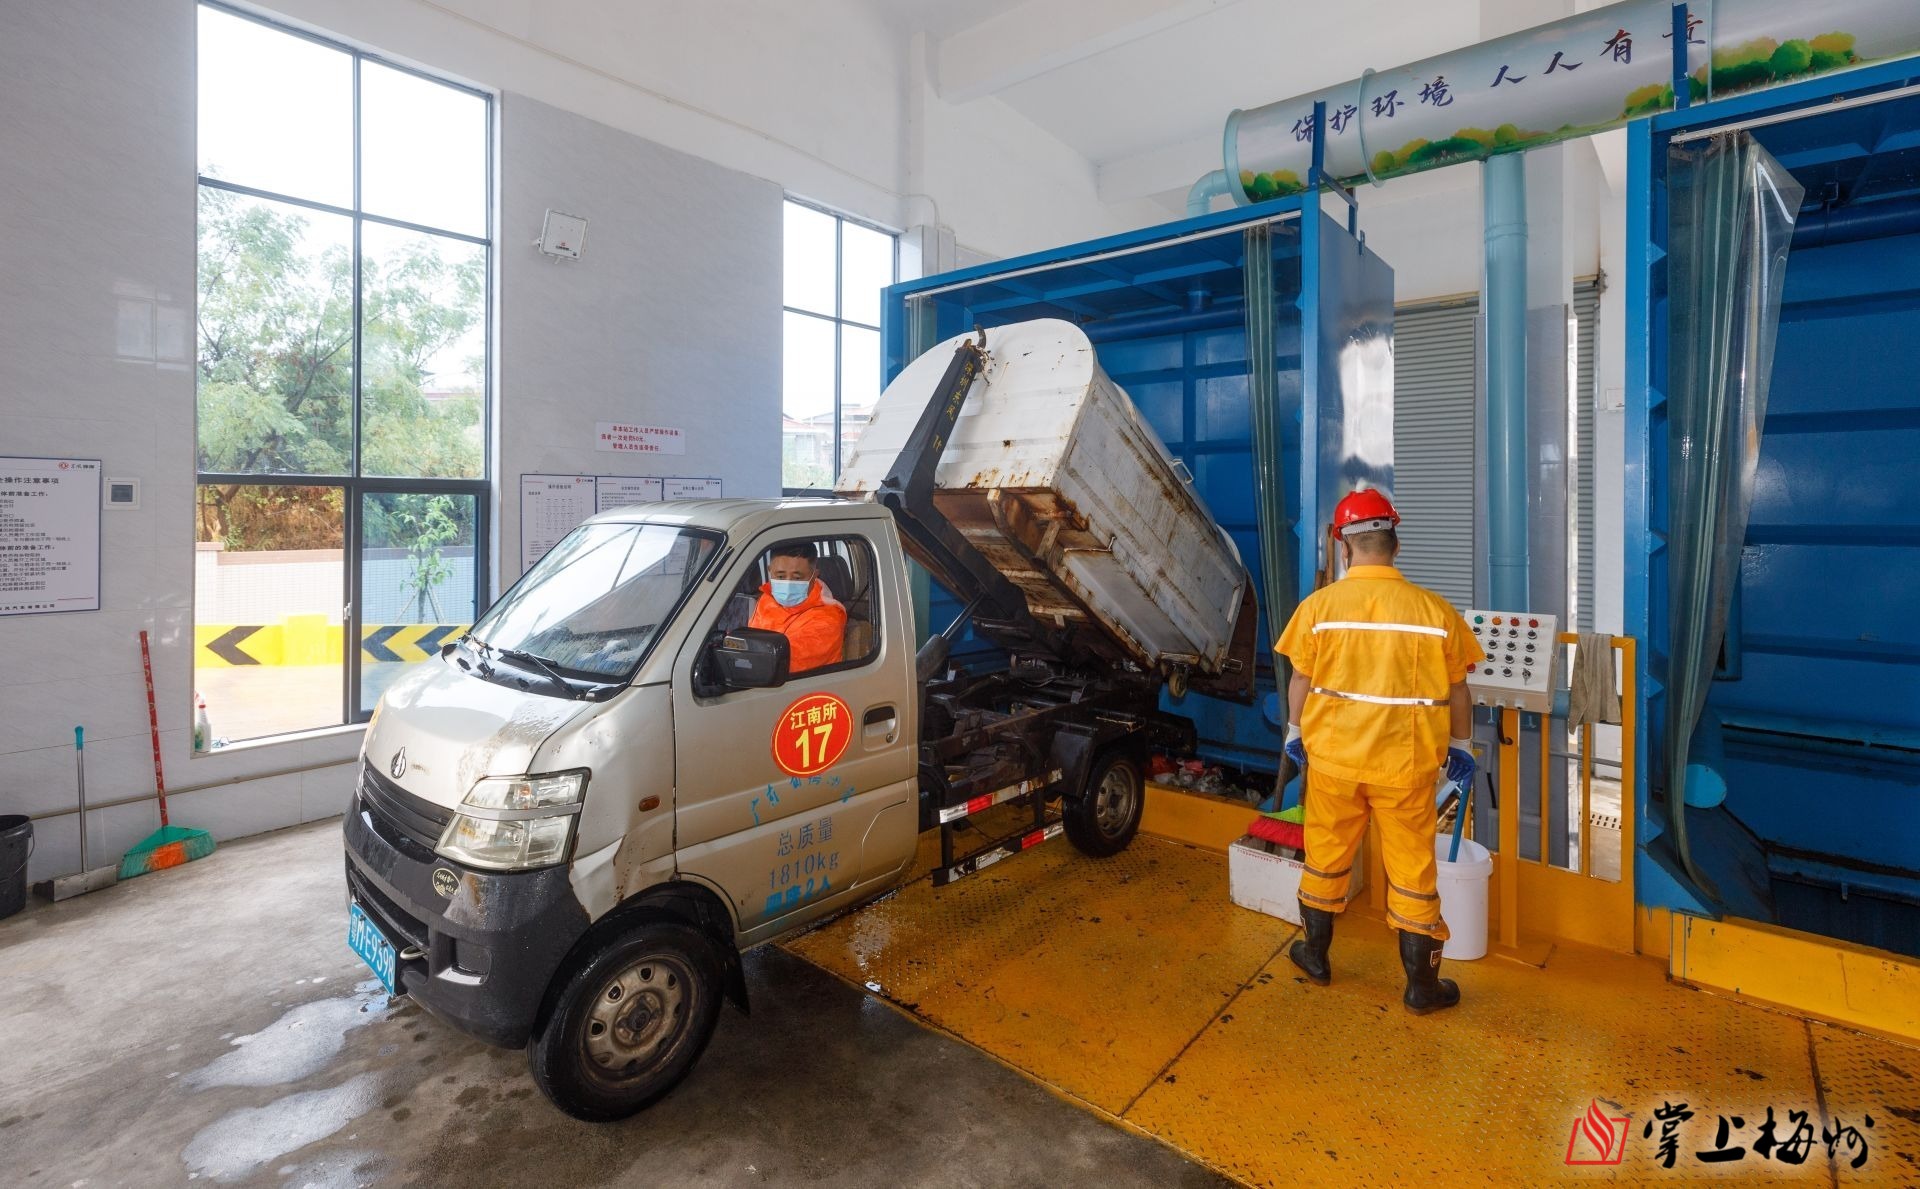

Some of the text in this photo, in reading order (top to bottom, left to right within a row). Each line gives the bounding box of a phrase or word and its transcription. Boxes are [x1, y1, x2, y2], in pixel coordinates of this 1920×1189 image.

[1291, 76, 1453, 142] 保护环境
[790, 701, 837, 730] 江南所
[795, 723, 833, 768] 17
[778, 816, 833, 857] 总质量
[769, 851, 840, 889] 1810kg
